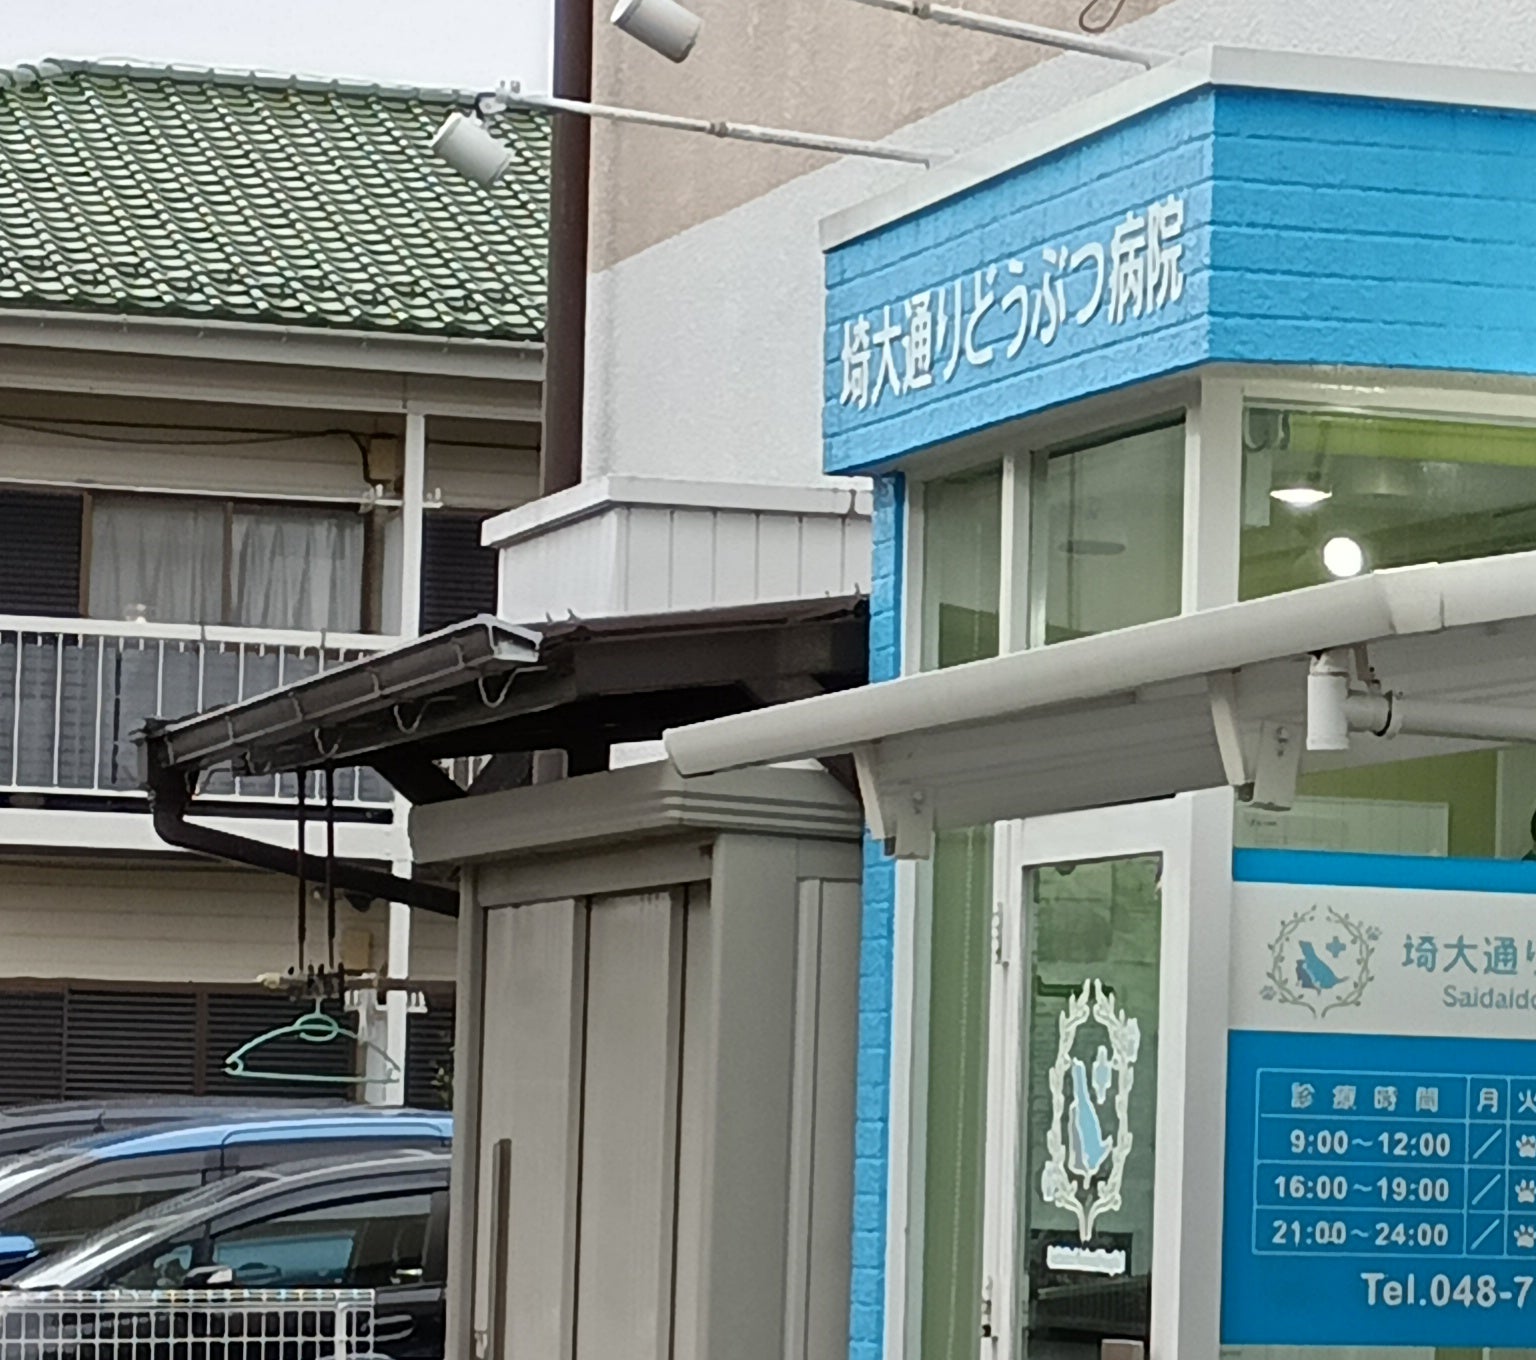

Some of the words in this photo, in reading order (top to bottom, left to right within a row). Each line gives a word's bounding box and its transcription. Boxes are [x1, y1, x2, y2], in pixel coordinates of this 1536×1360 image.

[838, 193, 1186, 410] 埼大通りどうぶつ病院
[1477, 1088, 1499, 1113] 月
